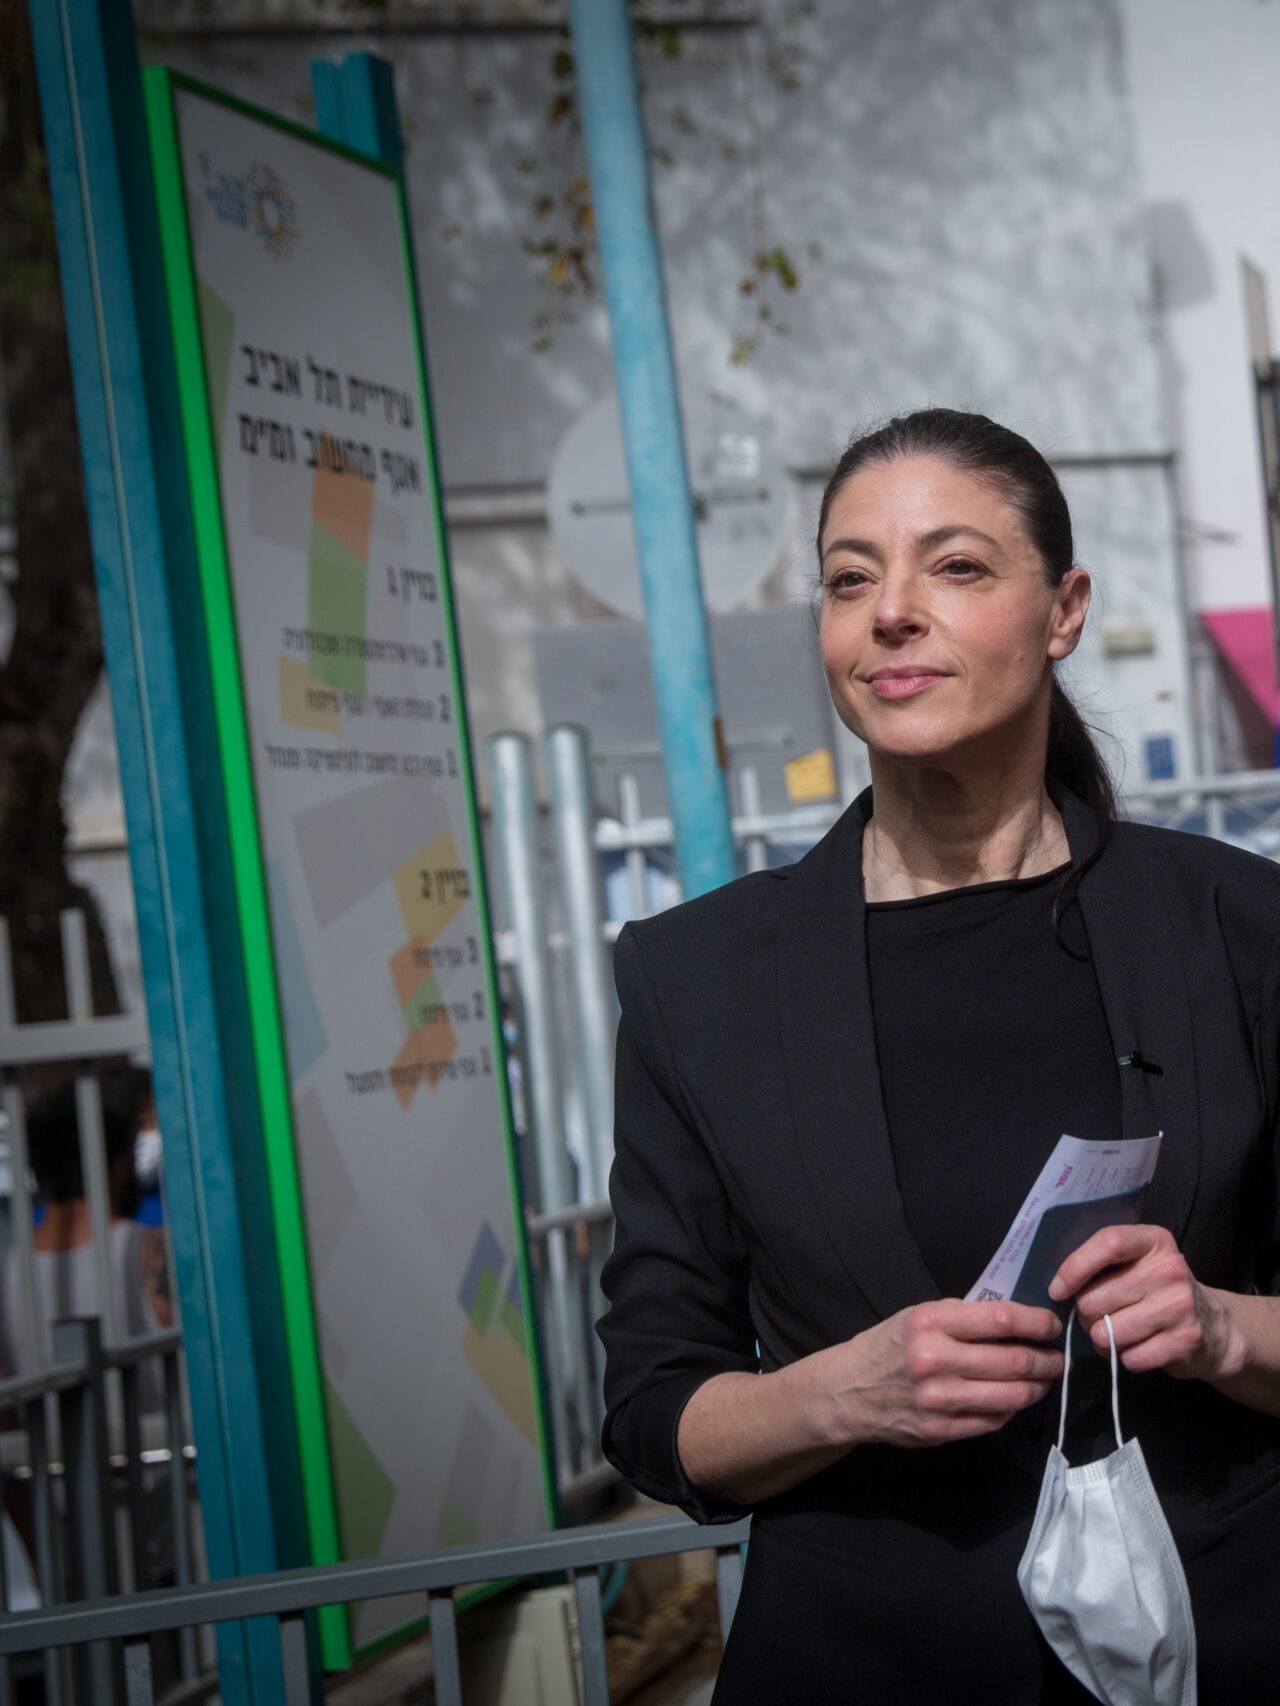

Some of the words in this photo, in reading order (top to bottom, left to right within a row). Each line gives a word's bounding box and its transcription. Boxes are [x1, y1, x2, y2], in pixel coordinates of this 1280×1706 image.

[240, 343, 302, 396] אביב
[306, 352, 343, 407] תל
[346, 374, 414, 428] עיריית
[437, 694, 451, 722] 2
[419, 868, 432, 899] 2
[465, 936, 479, 965] 3
[471, 991, 485, 1021] 2
